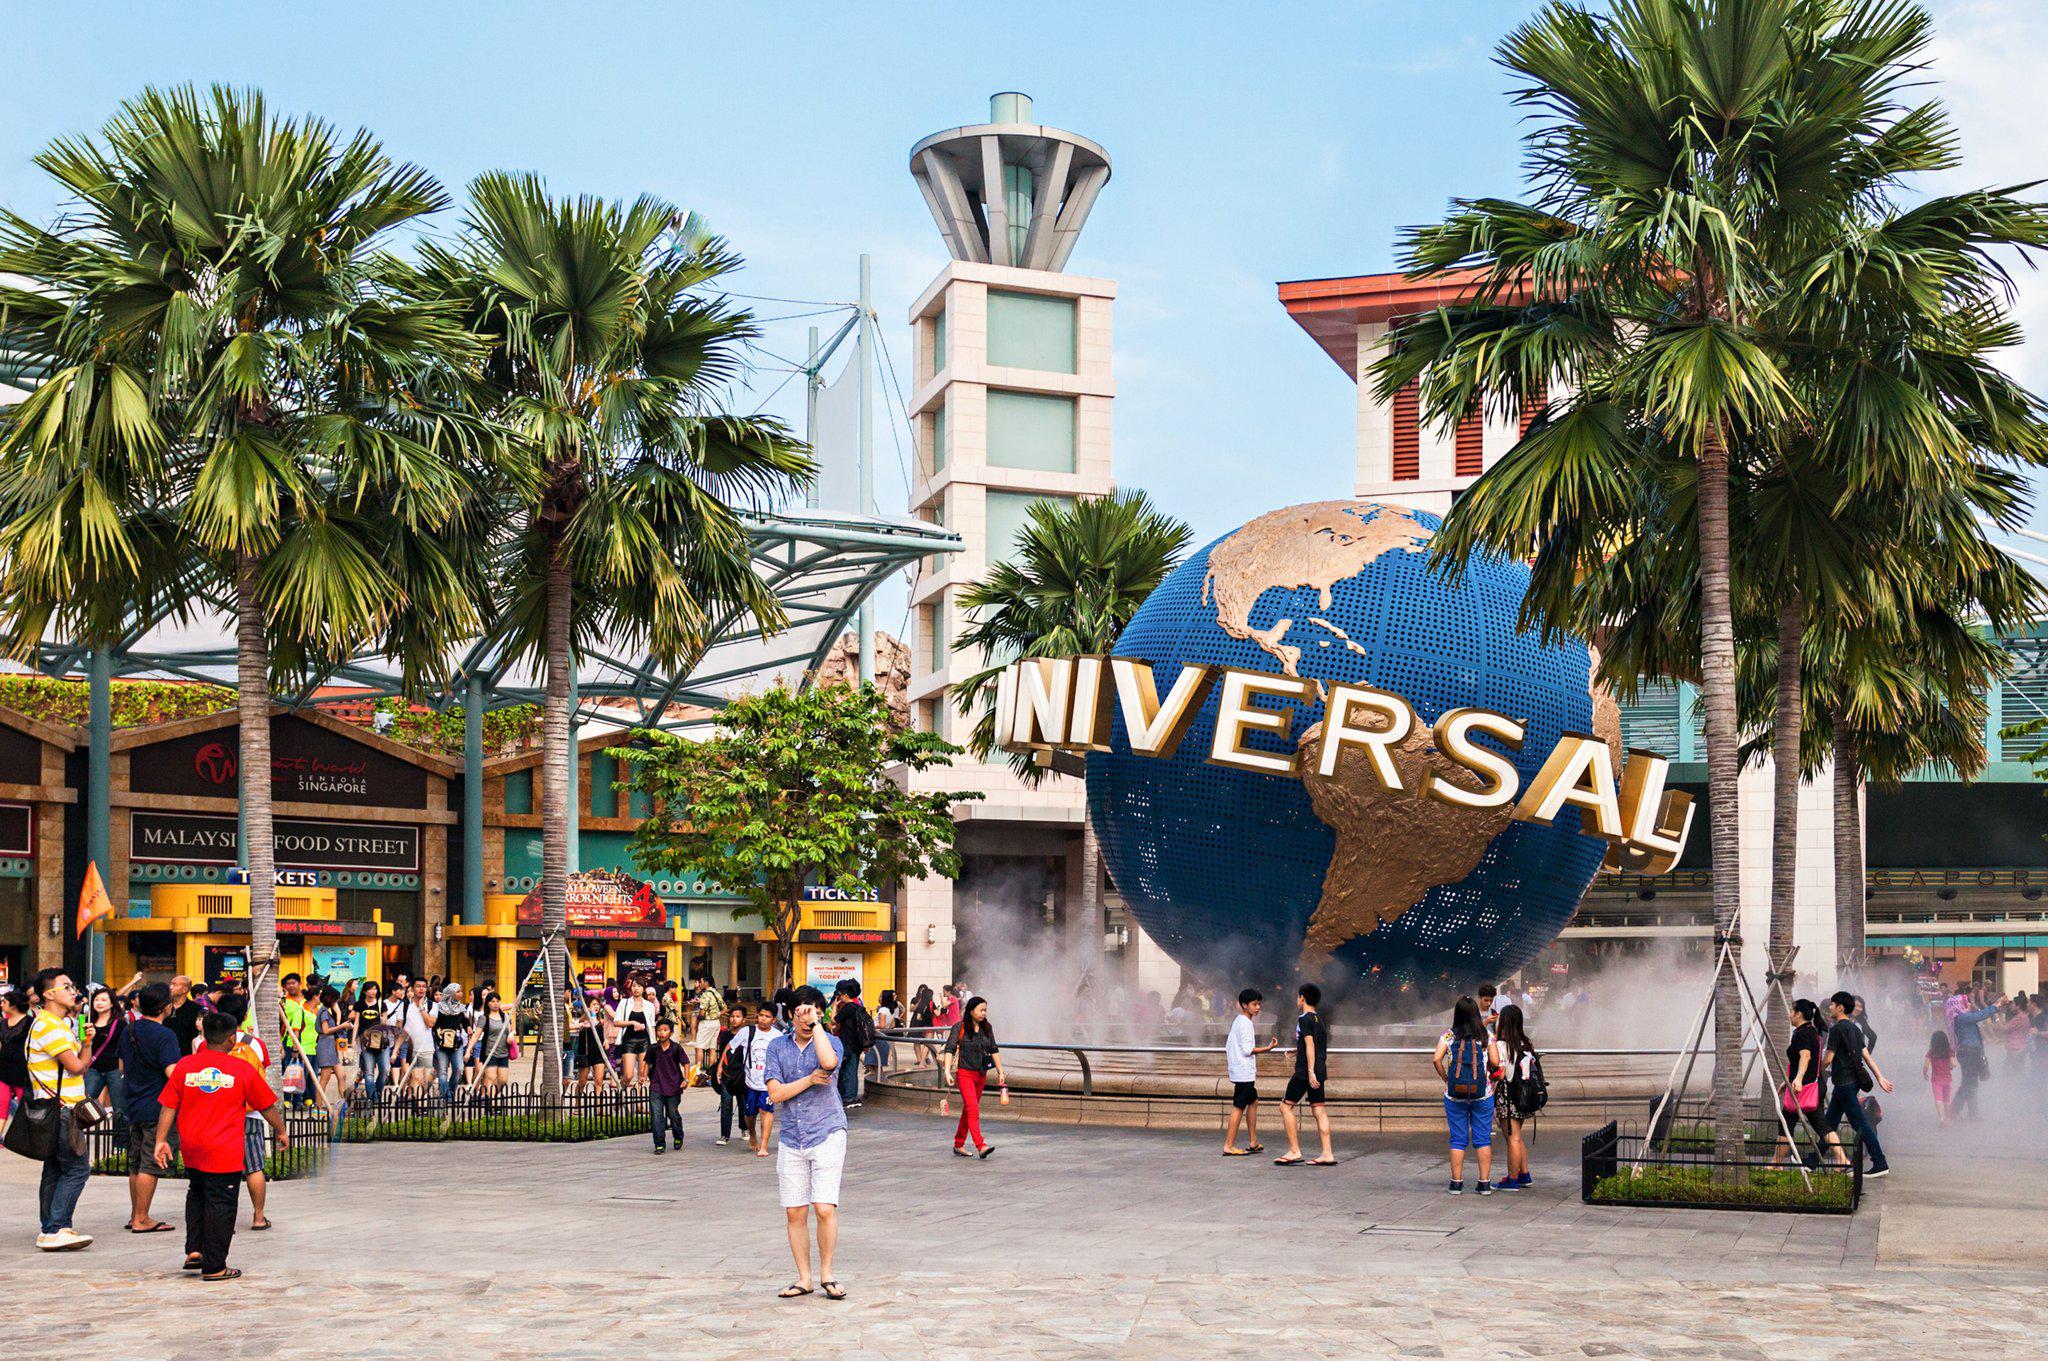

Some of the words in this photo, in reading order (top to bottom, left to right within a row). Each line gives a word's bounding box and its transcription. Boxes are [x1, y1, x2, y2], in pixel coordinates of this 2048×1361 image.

[298, 774, 367, 785] SENTOSA
[298, 781, 367, 795] SINGAPORE
[144, 828, 237, 848] MALAYSI
[273, 834, 331, 851] FOOD
[334, 836, 409, 855] STREET
[237, 869, 318, 886] TKETS
[1607, 871, 1709, 887] UDIO
[1873, 870, 2030, 887] GAPOR
[565, 882, 622, 894] ALLOWEEN
[808, 887, 878, 900] TICKTS
[591, 893, 634, 905] NIGHTS
[633, 883, 652, 917] 4
